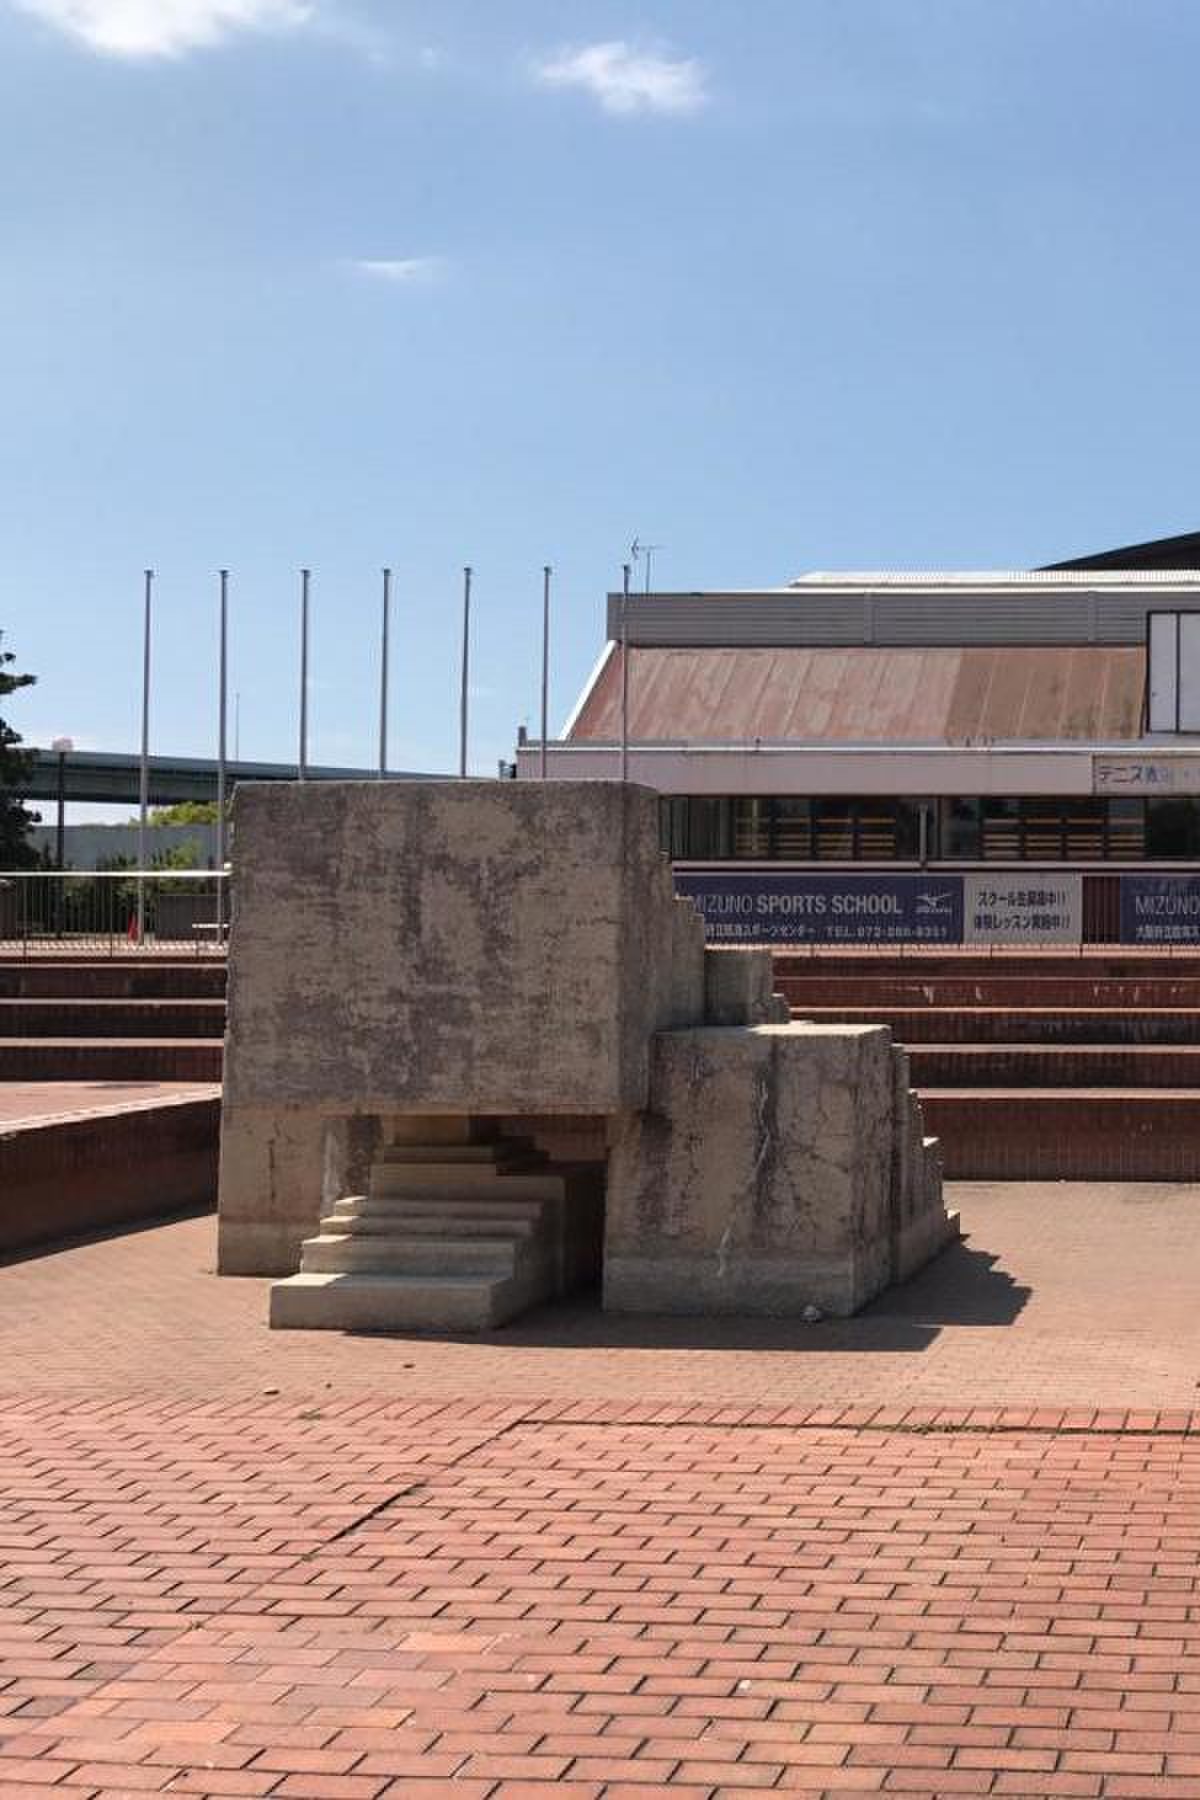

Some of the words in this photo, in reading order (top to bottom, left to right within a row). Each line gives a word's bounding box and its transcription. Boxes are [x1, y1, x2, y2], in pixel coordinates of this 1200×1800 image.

[757, 895, 827, 913] SPORTS
[831, 895, 903, 914] SCHOOL
[1136, 895, 1200, 914] MIZUNO
